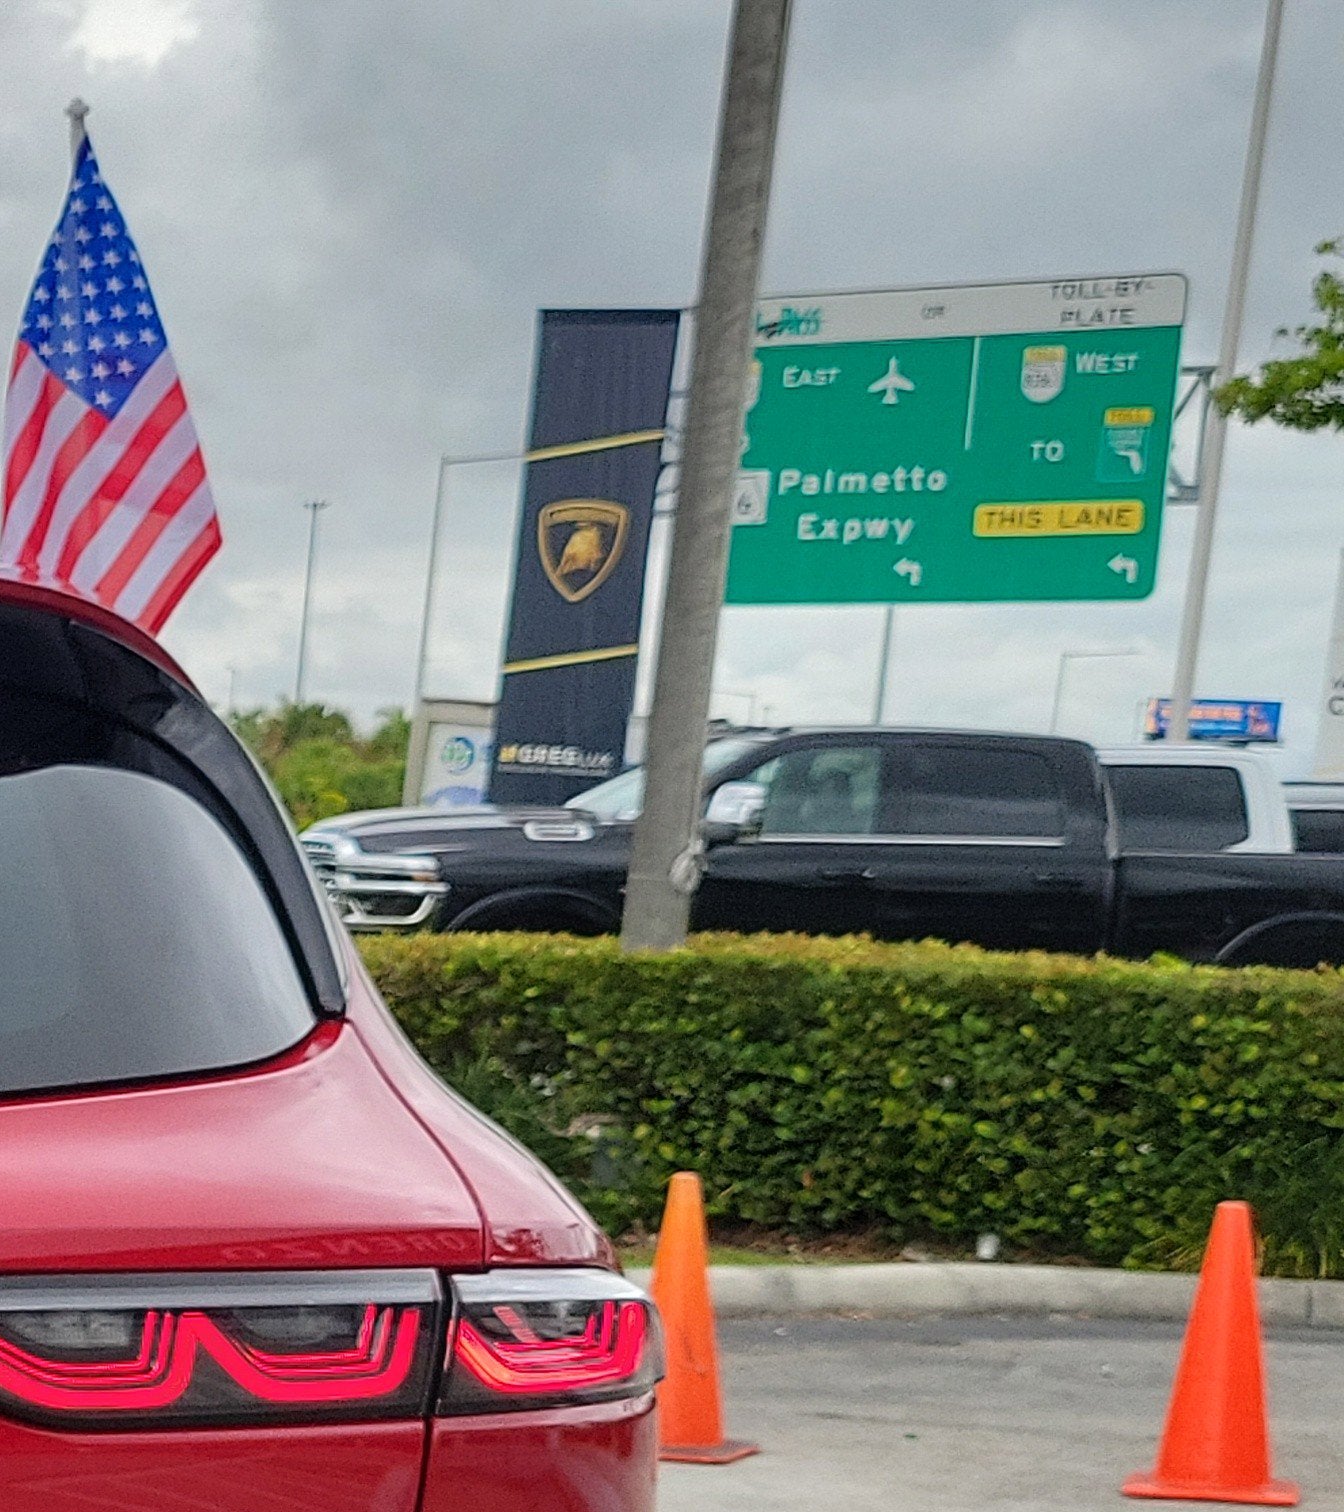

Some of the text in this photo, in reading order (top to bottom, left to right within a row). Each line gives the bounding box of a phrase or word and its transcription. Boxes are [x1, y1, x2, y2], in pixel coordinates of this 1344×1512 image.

[1060, 308, 1136, 327] PLATE
[1075, 351, 1139, 374] WEST
[782, 365, 842, 388] EAST
[1030, 440, 1064, 462] TO
[778, 465, 947, 495] Palmetto
[797, 512, 915, 545] Expwy
[985, 507, 1135, 530] THIS LANE
